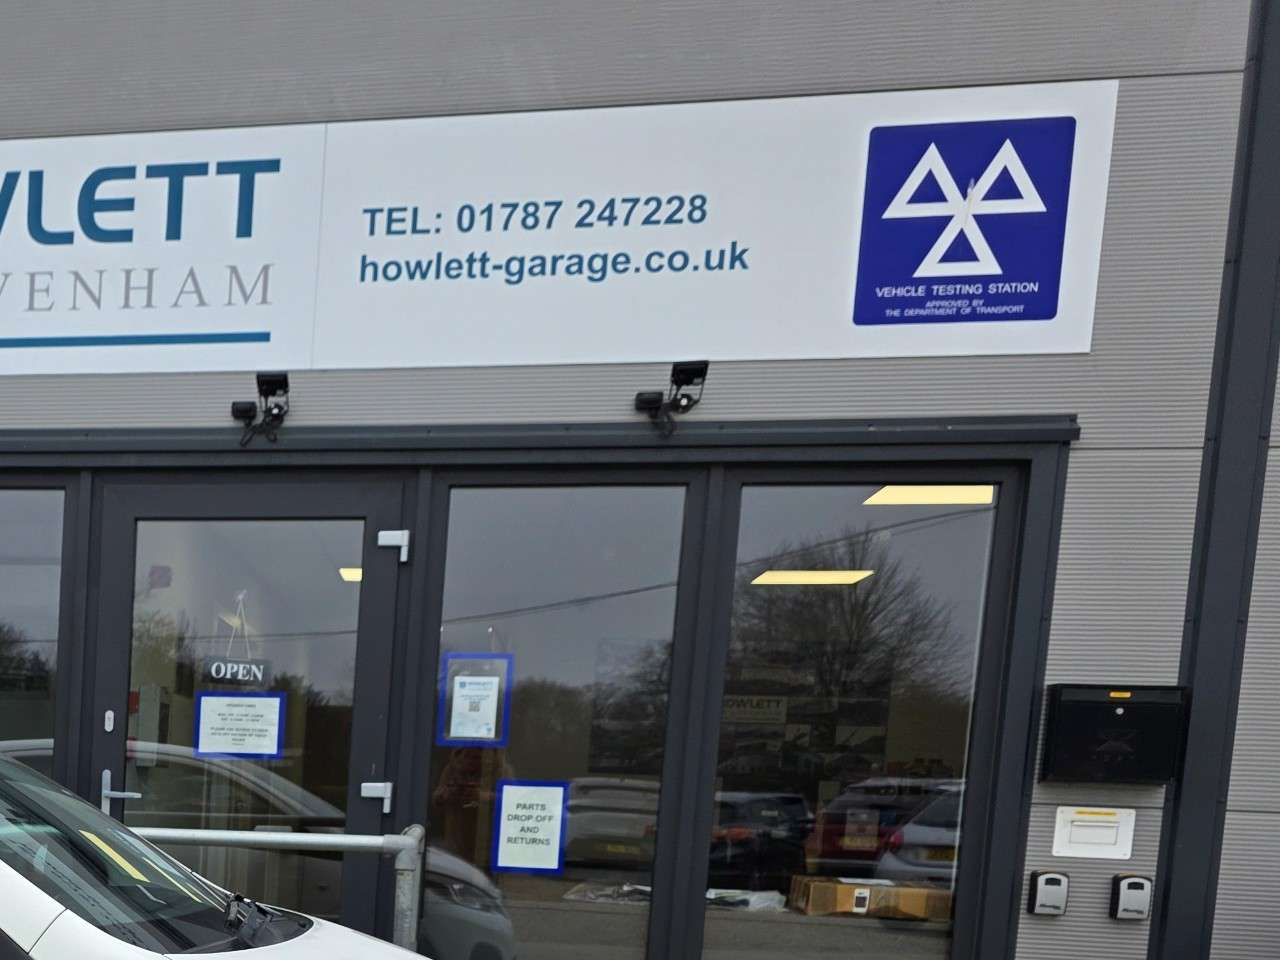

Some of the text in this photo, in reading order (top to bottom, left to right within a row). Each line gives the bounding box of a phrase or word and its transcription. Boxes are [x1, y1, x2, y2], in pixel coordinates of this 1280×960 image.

[362, 194, 709, 236] TEL: 01787 247228
[359, 240, 751, 286] howlett-garage.co.uk
[875, 281, 1039, 298] VEHICLE TESTING STATION
[925, 300, 970, 308] APPROVED
[885, 305, 1025, 318] THE DEPARTMENT OF TRANSPORT
[211, 662, 264, 681] OPEN
[515, 802, 547, 811] PARTS
[507, 814, 555, 823] DROP OFF
[520, 825, 540, 834] AND
[506, 836, 551, 846] RETURNS
